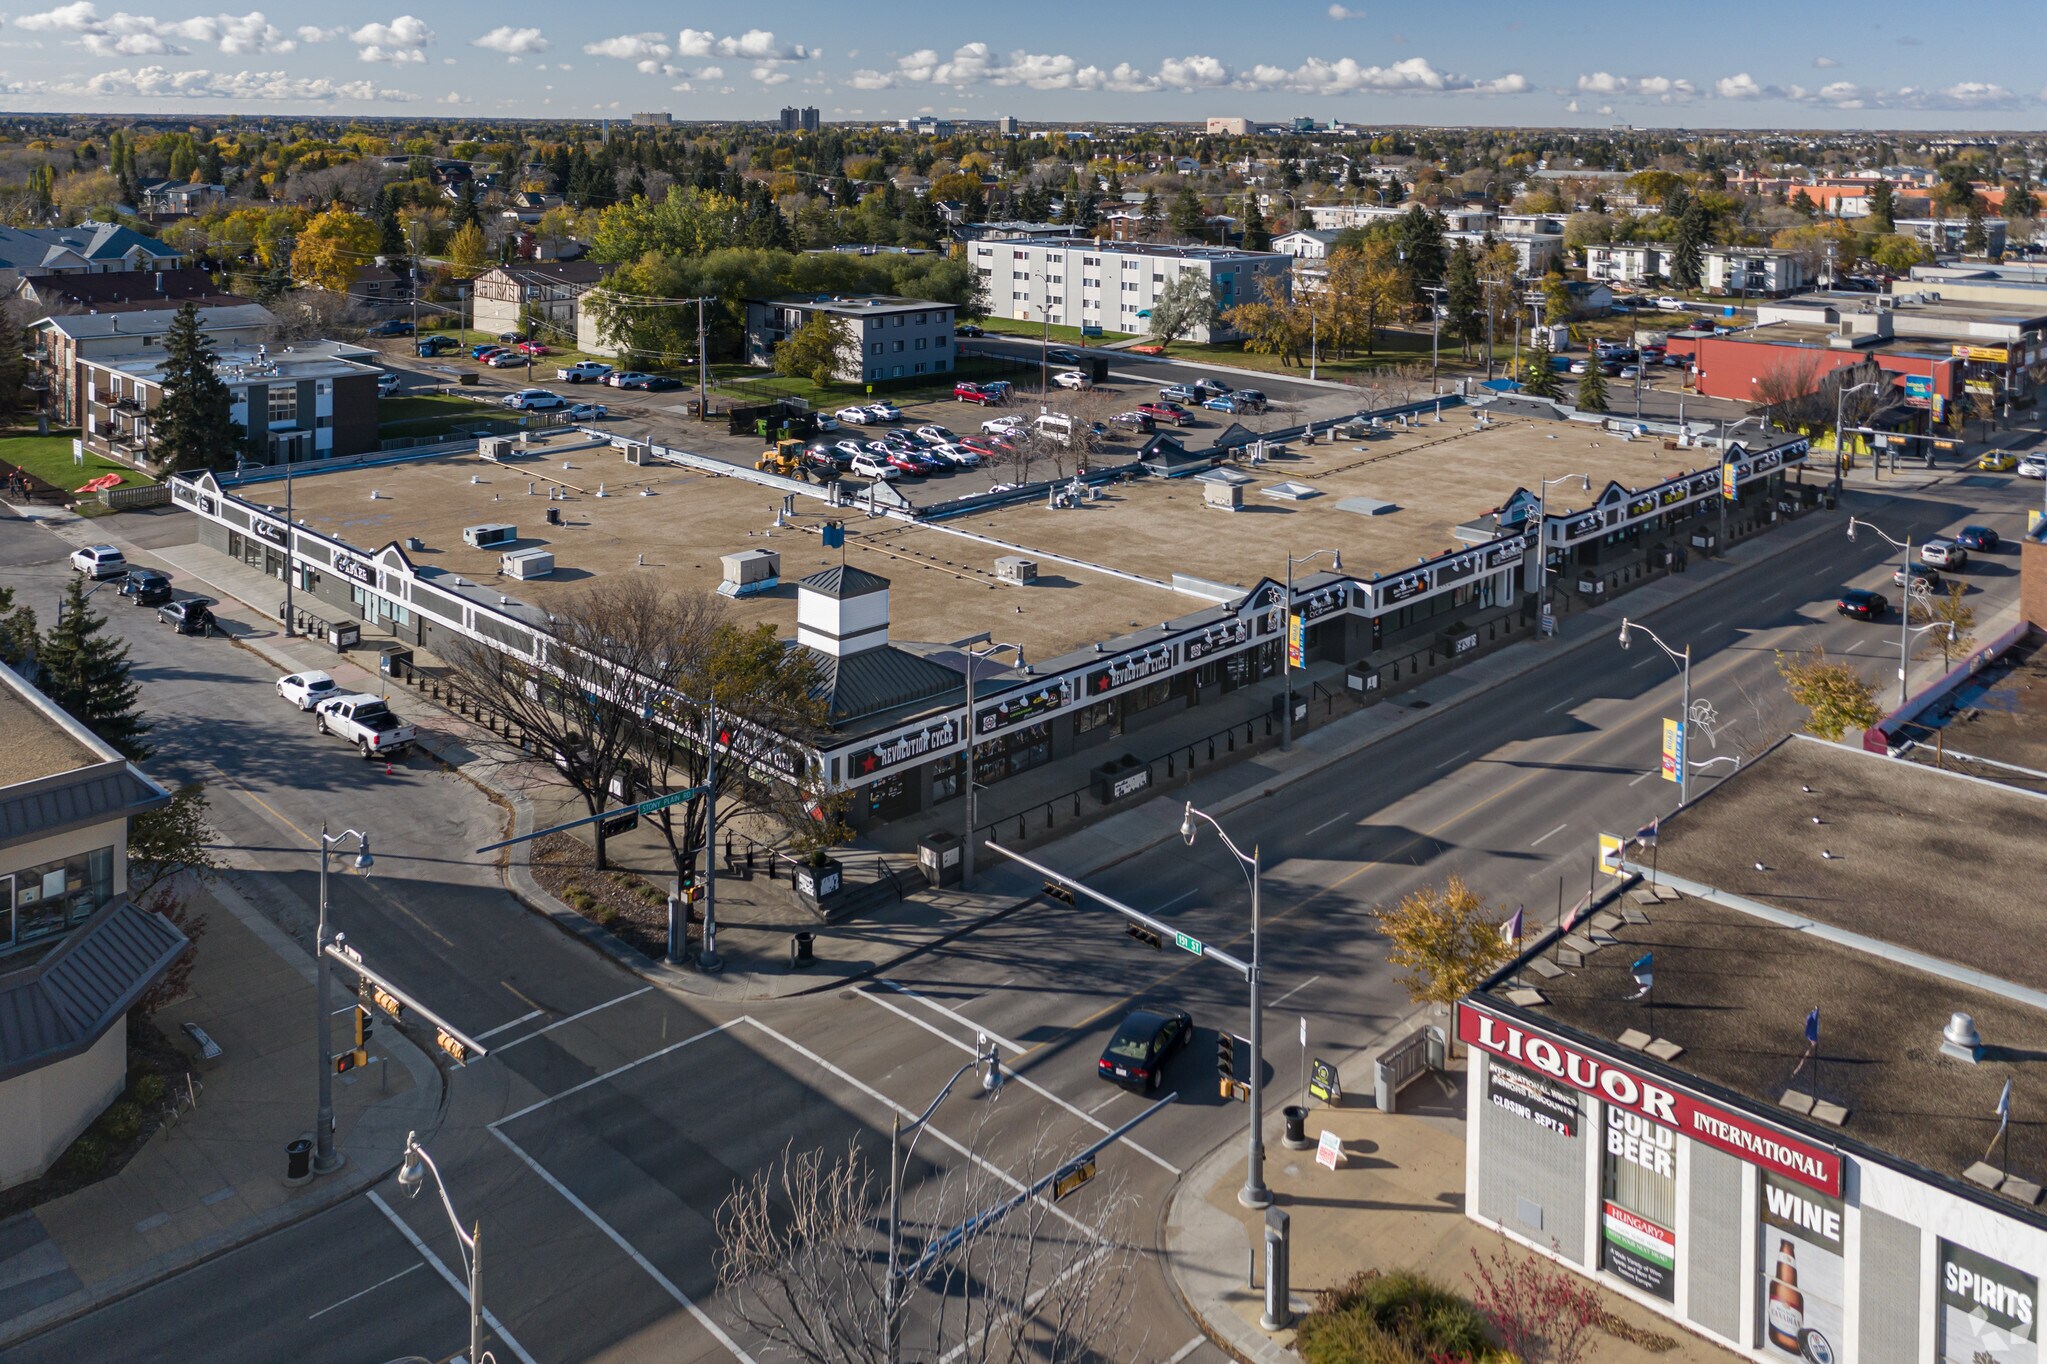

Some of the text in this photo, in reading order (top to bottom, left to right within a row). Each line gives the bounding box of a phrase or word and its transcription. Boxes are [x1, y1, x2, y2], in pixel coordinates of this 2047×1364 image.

[1112, 655, 1169, 687] REVOLUTION CYCLE
[881, 729, 954, 766] REVOLUTION CYCLE
[642, 791, 691, 813] STONY PLAIN RD
[1178, 934, 1199, 952] 151 ST
[1476, 1013, 1680, 1127] LIQUOR
[1489, 1062, 1551, 1097] INTERNATIONAL
[1493, 1093, 1531, 1120] CLOSING
[1534, 1111, 1558, 1132] SEPT
[1528, 1090, 1575, 1119] DISCOUNTS
[1607, 1105, 1673, 1152] COLD
[1692, 1110, 1828, 1182] INTERNATIONAL
[1607, 1126, 1673, 1179] BEER
[1611, 1207, 1664, 1240] HUNGARY?
[1765, 1183, 1841, 1242] WINE
[1944, 1260, 2034, 1325] SPIRITS
